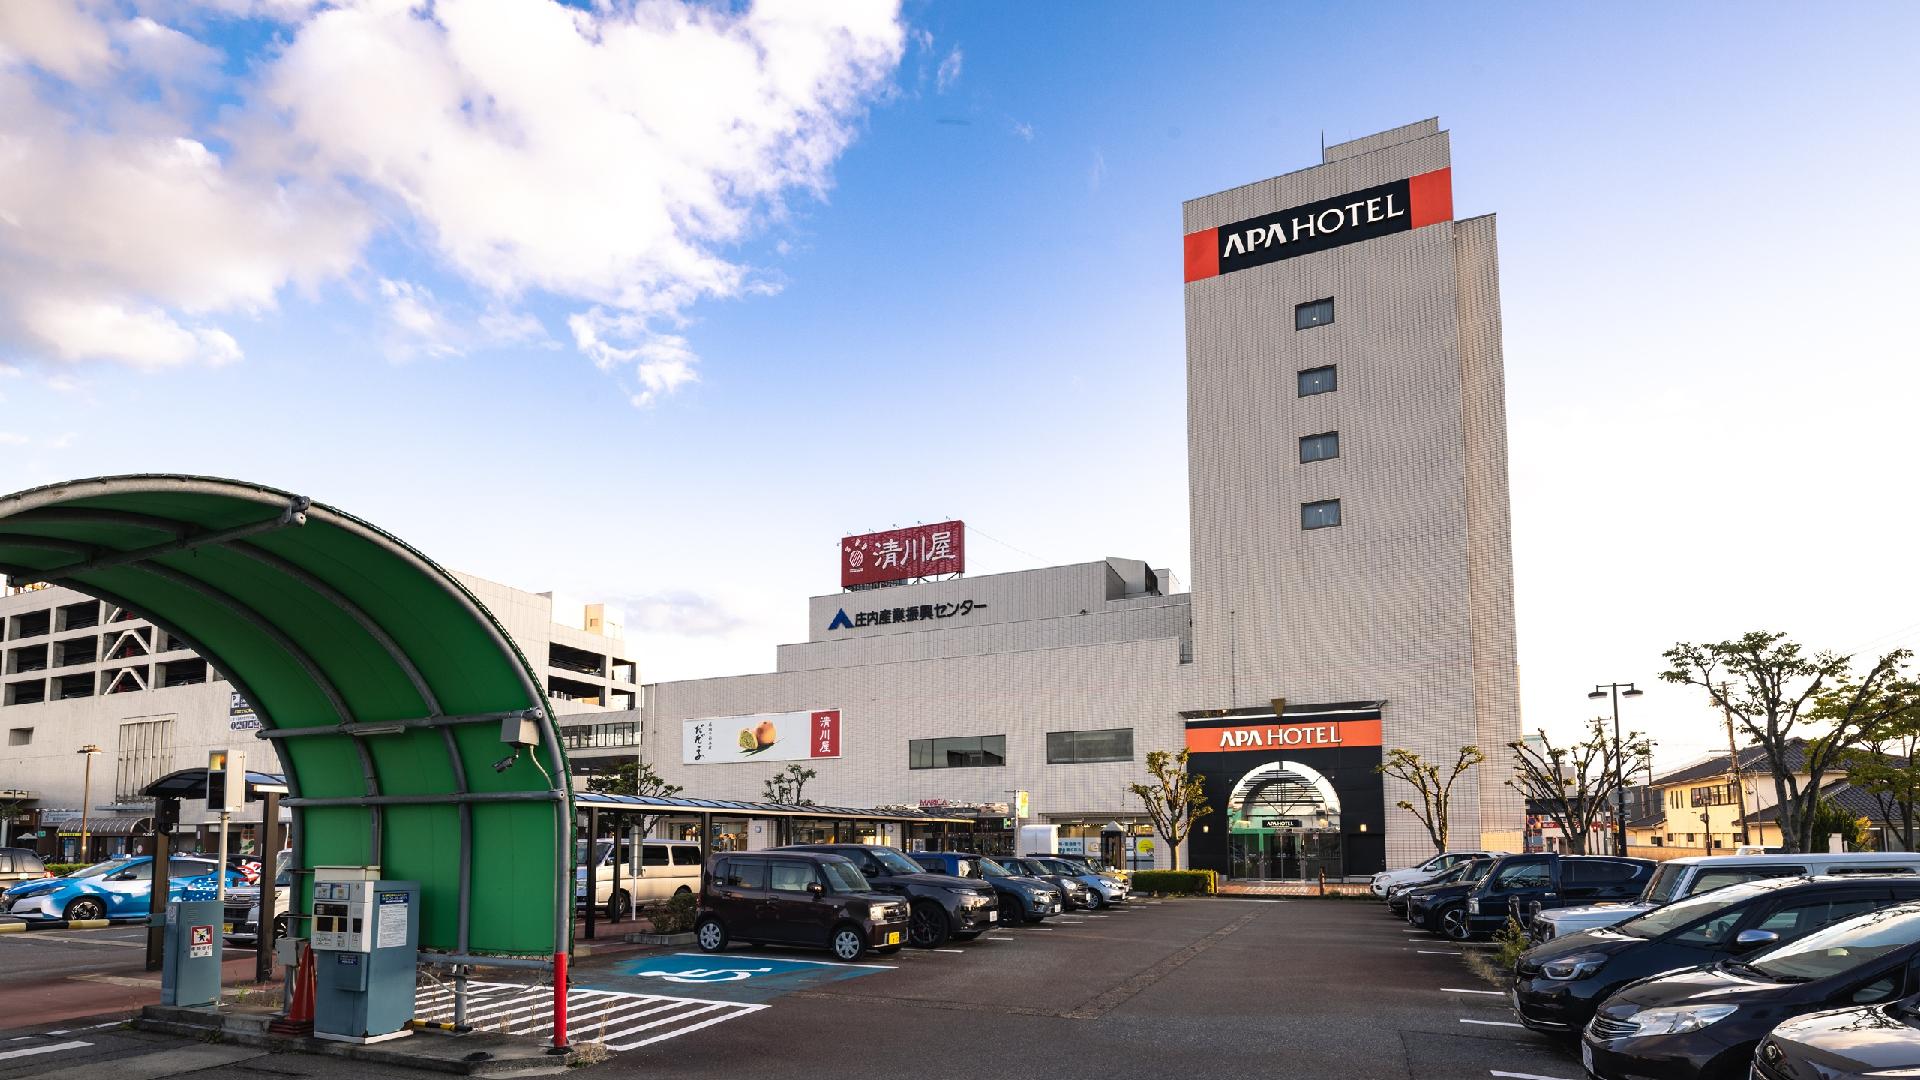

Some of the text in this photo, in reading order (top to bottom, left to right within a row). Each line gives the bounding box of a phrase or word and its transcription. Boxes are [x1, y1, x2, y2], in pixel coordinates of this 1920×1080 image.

[1223, 193, 1404, 258] APA HOTEL
[873, 531, 956, 569] 清川屋
[854, 599, 988, 627] 庄内産業振興センター
[819, 716, 831, 753] 清川屋
[1219, 726, 1342, 747] APA HOTEL
